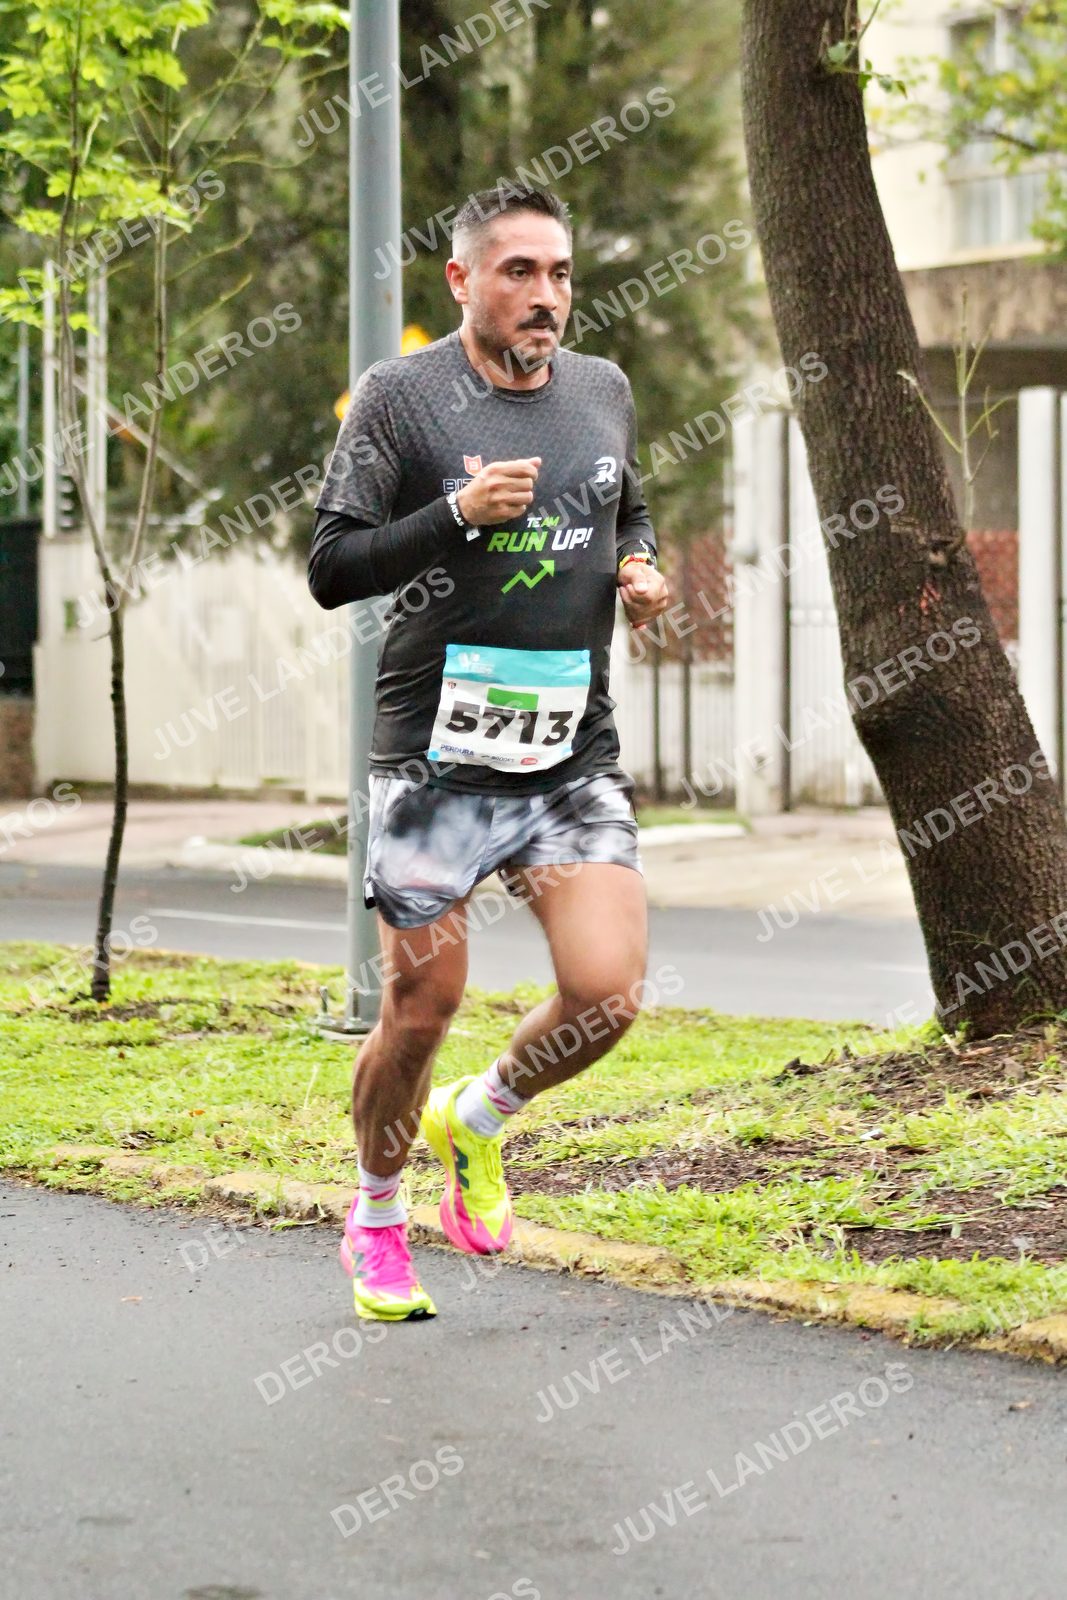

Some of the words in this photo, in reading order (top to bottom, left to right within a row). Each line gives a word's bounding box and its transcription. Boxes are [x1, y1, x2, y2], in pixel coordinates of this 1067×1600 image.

[526, 516, 560, 528] TEAM
[486, 530, 549, 552] RUN
[551, 527, 594, 551] UP!
[445, 700, 574, 746] 5713
